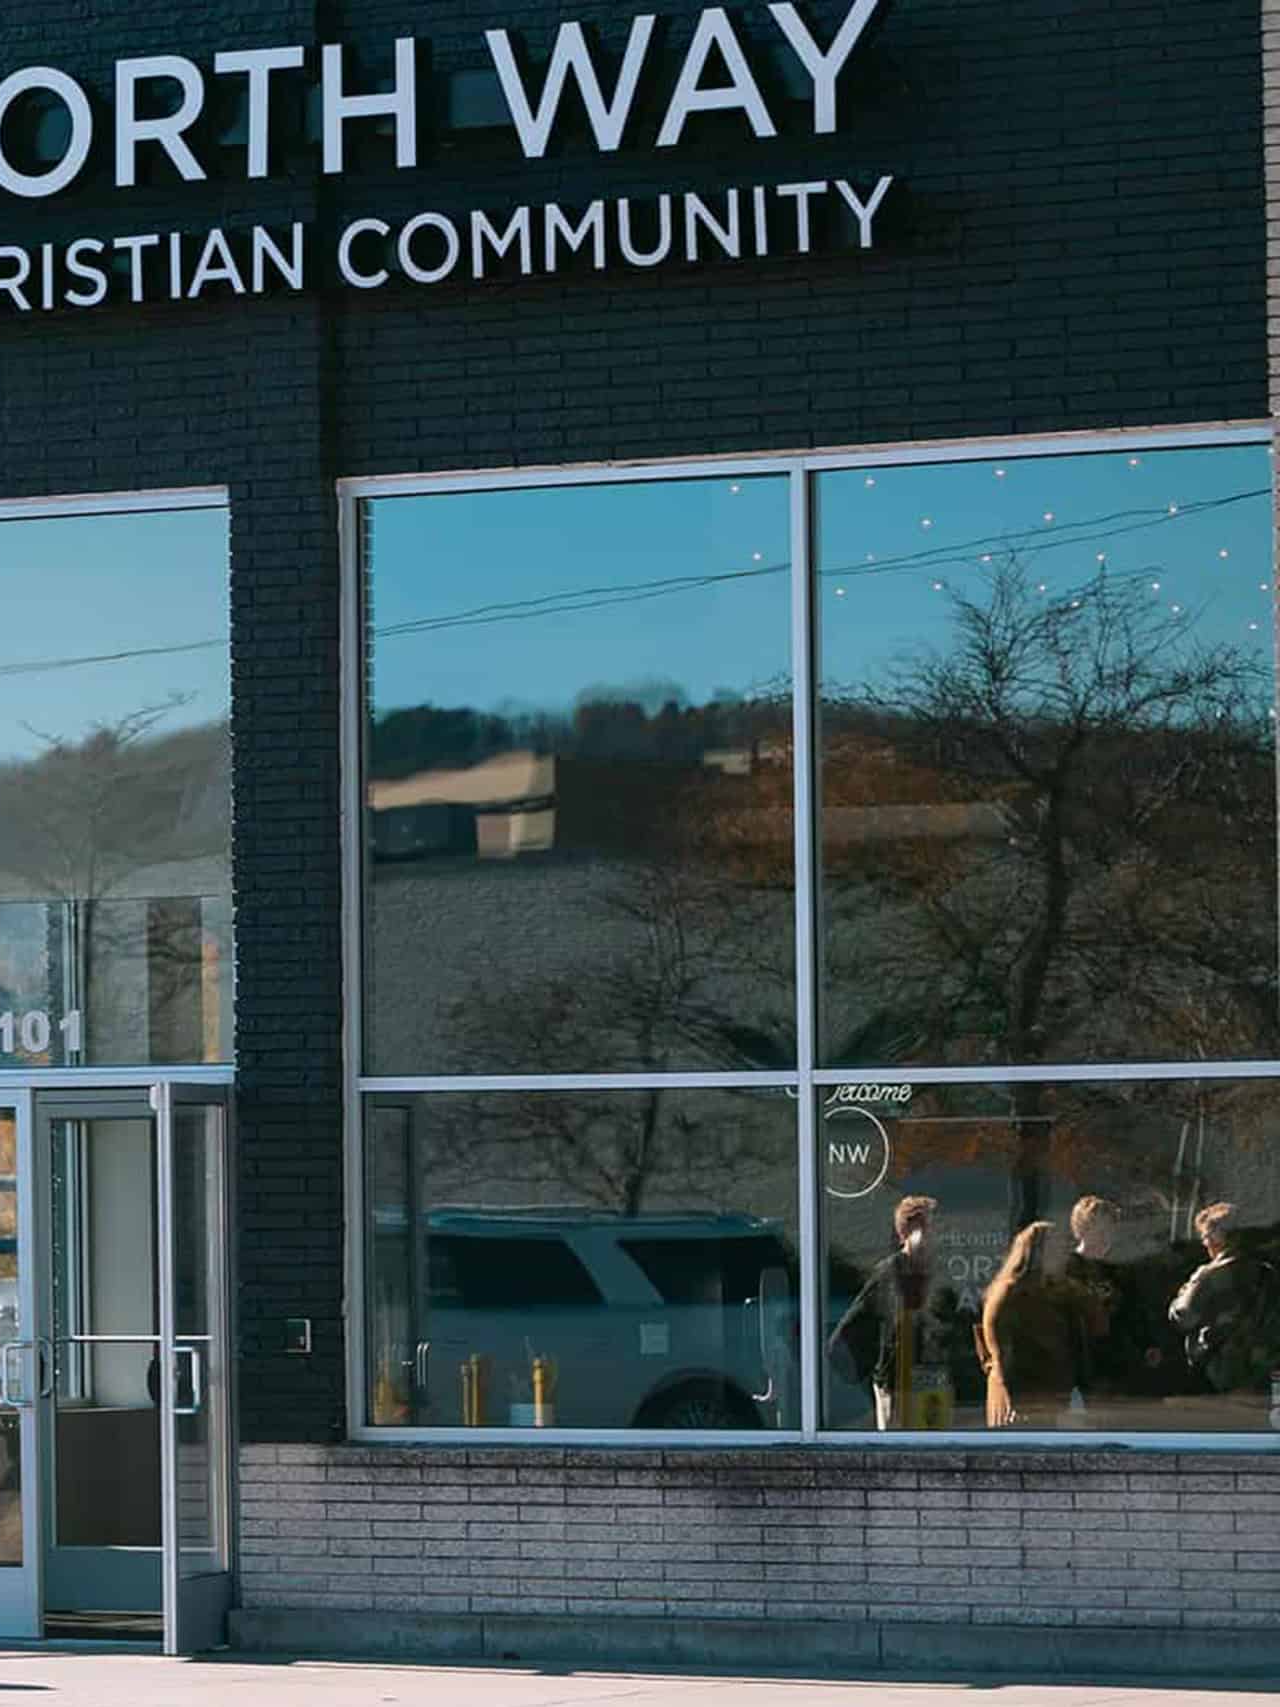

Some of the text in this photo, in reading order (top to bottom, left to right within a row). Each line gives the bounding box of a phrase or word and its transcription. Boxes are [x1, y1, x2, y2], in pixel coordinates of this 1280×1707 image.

[485, 0, 880, 158] WAY
[337, 175, 894, 290] COMMUNITY
[828, 1143, 870, 1165] NW
